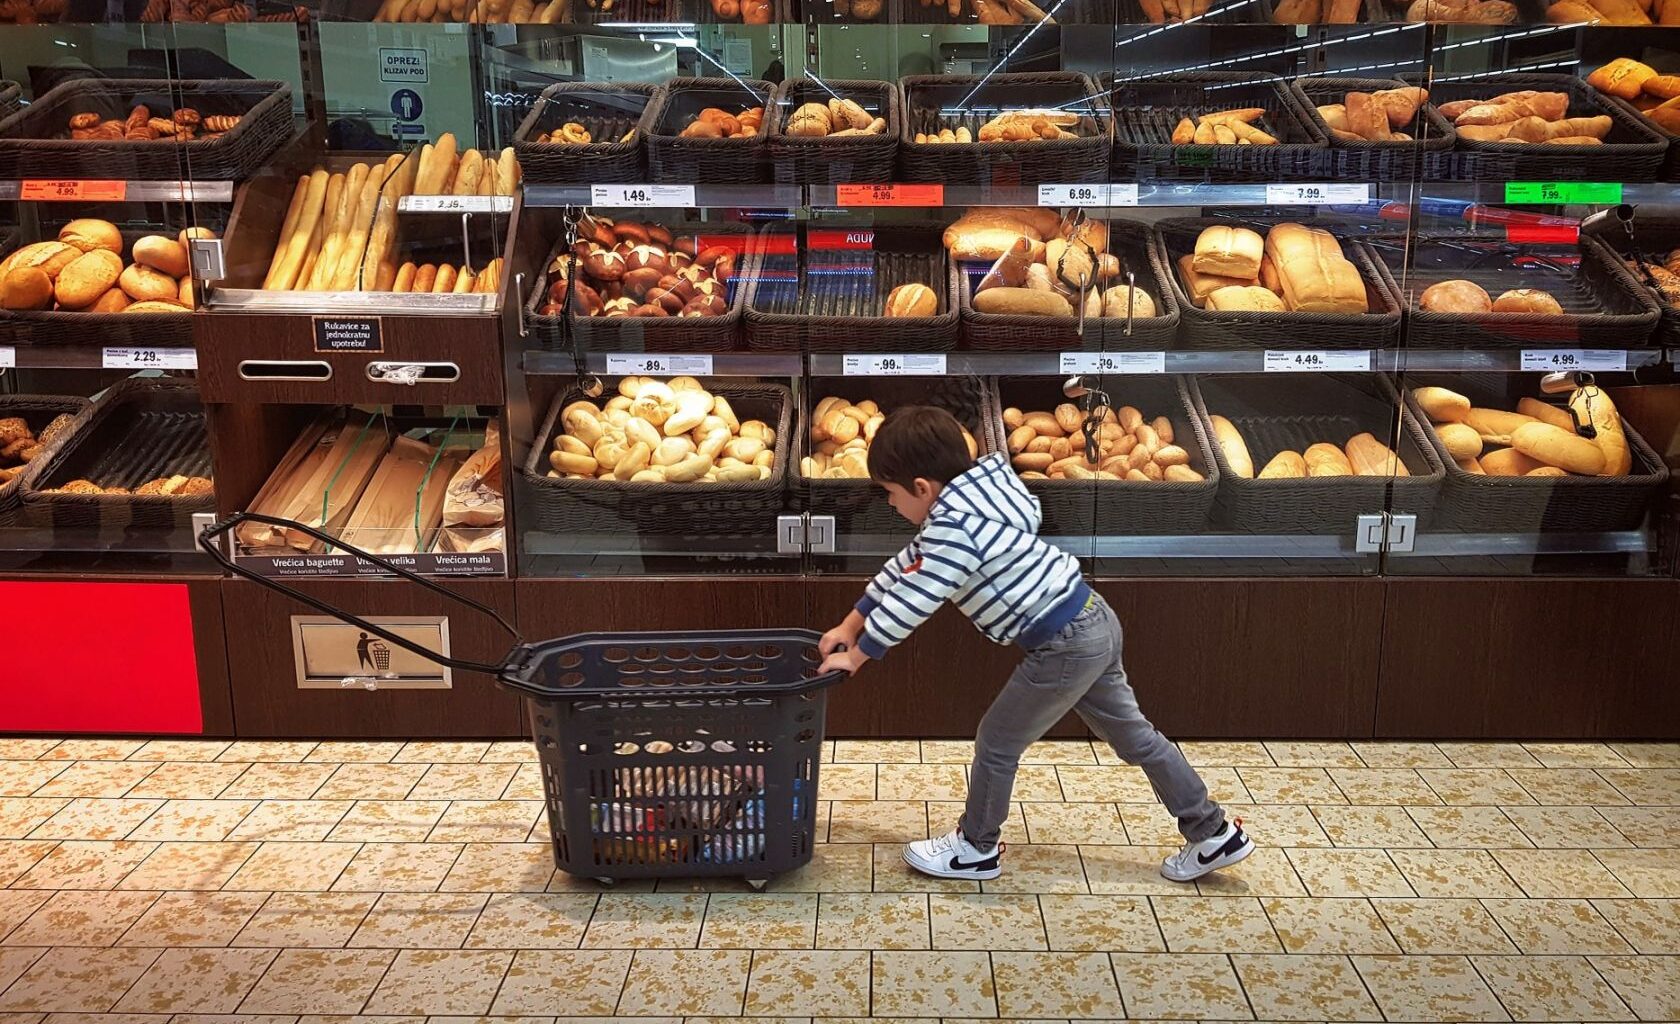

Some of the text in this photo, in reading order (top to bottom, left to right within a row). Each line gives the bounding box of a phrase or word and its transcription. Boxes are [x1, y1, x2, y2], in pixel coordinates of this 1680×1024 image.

[387, 56, 420, 65] OPREZ!
[56, 187, 74, 196] 4.99
[623, 190, 645, 201] 1.49
[872, 190, 890, 200] 4.99
[1069, 188, 1091, 199] 6.99
[1297, 188, 1319, 198] 7.99
[1541, 190, 1558, 199] 7.99
[324, 322, 359, 330] Rukavice
[326, 331, 370, 340] jednokratnu
[331, 340, 366, 349] upotrebu!
[134, 351, 156, 361] 2.29
[1295, 354, 1318, 364] 4.49
[1552, 354, 1574, 364] 4.99
[272, 557, 345, 568] Vrećica baguette
[390, 556, 416, 565] velika
[435, 555, 491, 564] Vrećica mala
